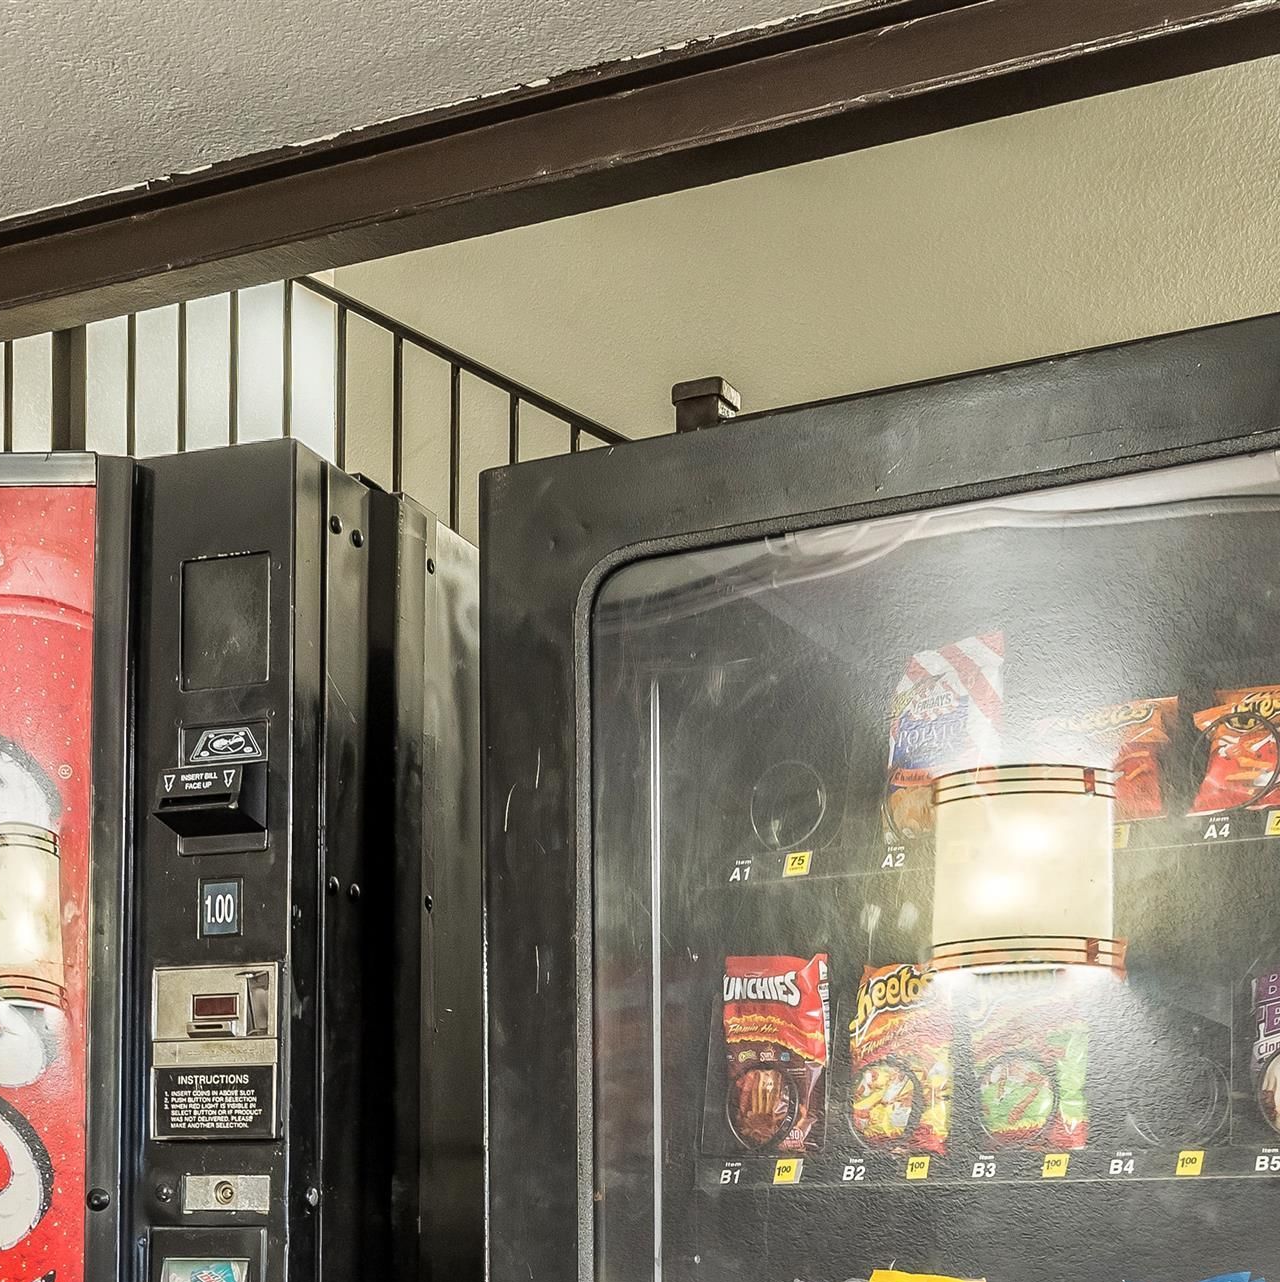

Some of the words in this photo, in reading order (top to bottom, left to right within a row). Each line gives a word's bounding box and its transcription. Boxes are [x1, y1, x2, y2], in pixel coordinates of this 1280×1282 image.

[181, 773, 203, 782] INSERT
[204, 772, 218, 780] BILL
[185, 782, 201, 790] FACE
[202, 781, 212, 789] UP
[1204, 823, 1231, 840] A4
[881, 853, 905, 868] A2
[729, 867, 751, 882] A1
[204, 893, 234, 925] 1.00
[723, 971, 800, 1007] UNCHIES
[178, 1074, 249, 1085] INSTRUCTIONS
[842, 1166, 866, 1181] B2
